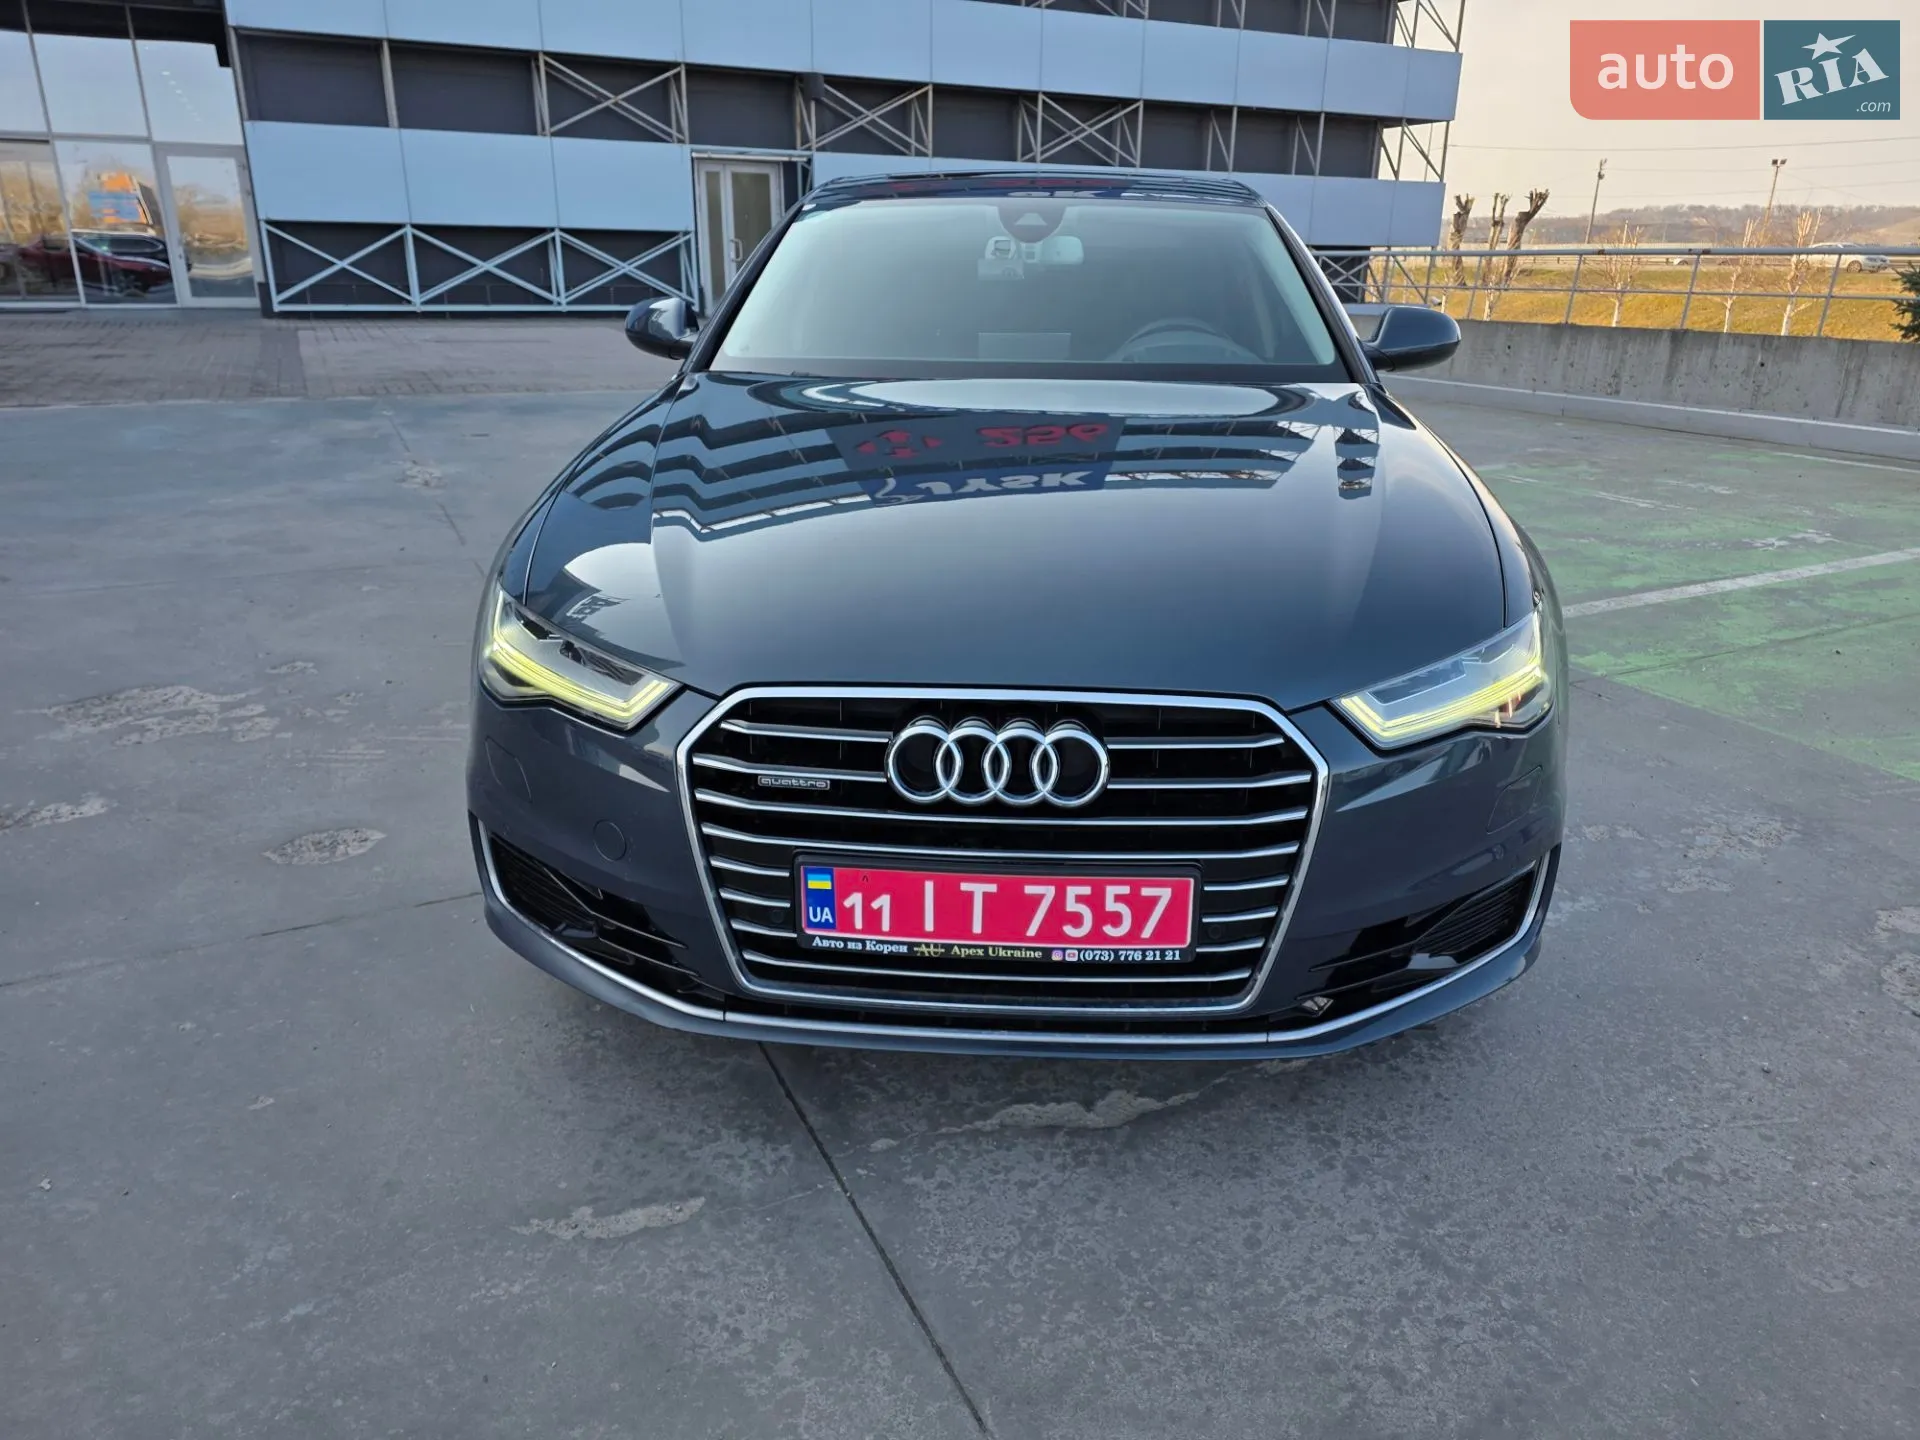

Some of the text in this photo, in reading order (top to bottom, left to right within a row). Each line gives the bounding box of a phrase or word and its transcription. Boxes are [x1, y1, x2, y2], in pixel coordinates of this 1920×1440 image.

[761, 777, 827, 789] quattro
[808, 906, 834, 924] UA
[843, 892, 891, 932] 11
[1024, 884, 1172, 939] 7557
[812, 936, 844, 948] Авто
[951, 945, 984, 957] Apex
[988, 946, 1043, 959] Ukraine
[1080, 950, 1114, 962] (073)
[1118, 950, 1142, 961] 776
[1145, 950, 1161, 961] 21
[1165, 950, 1181, 961] 21
